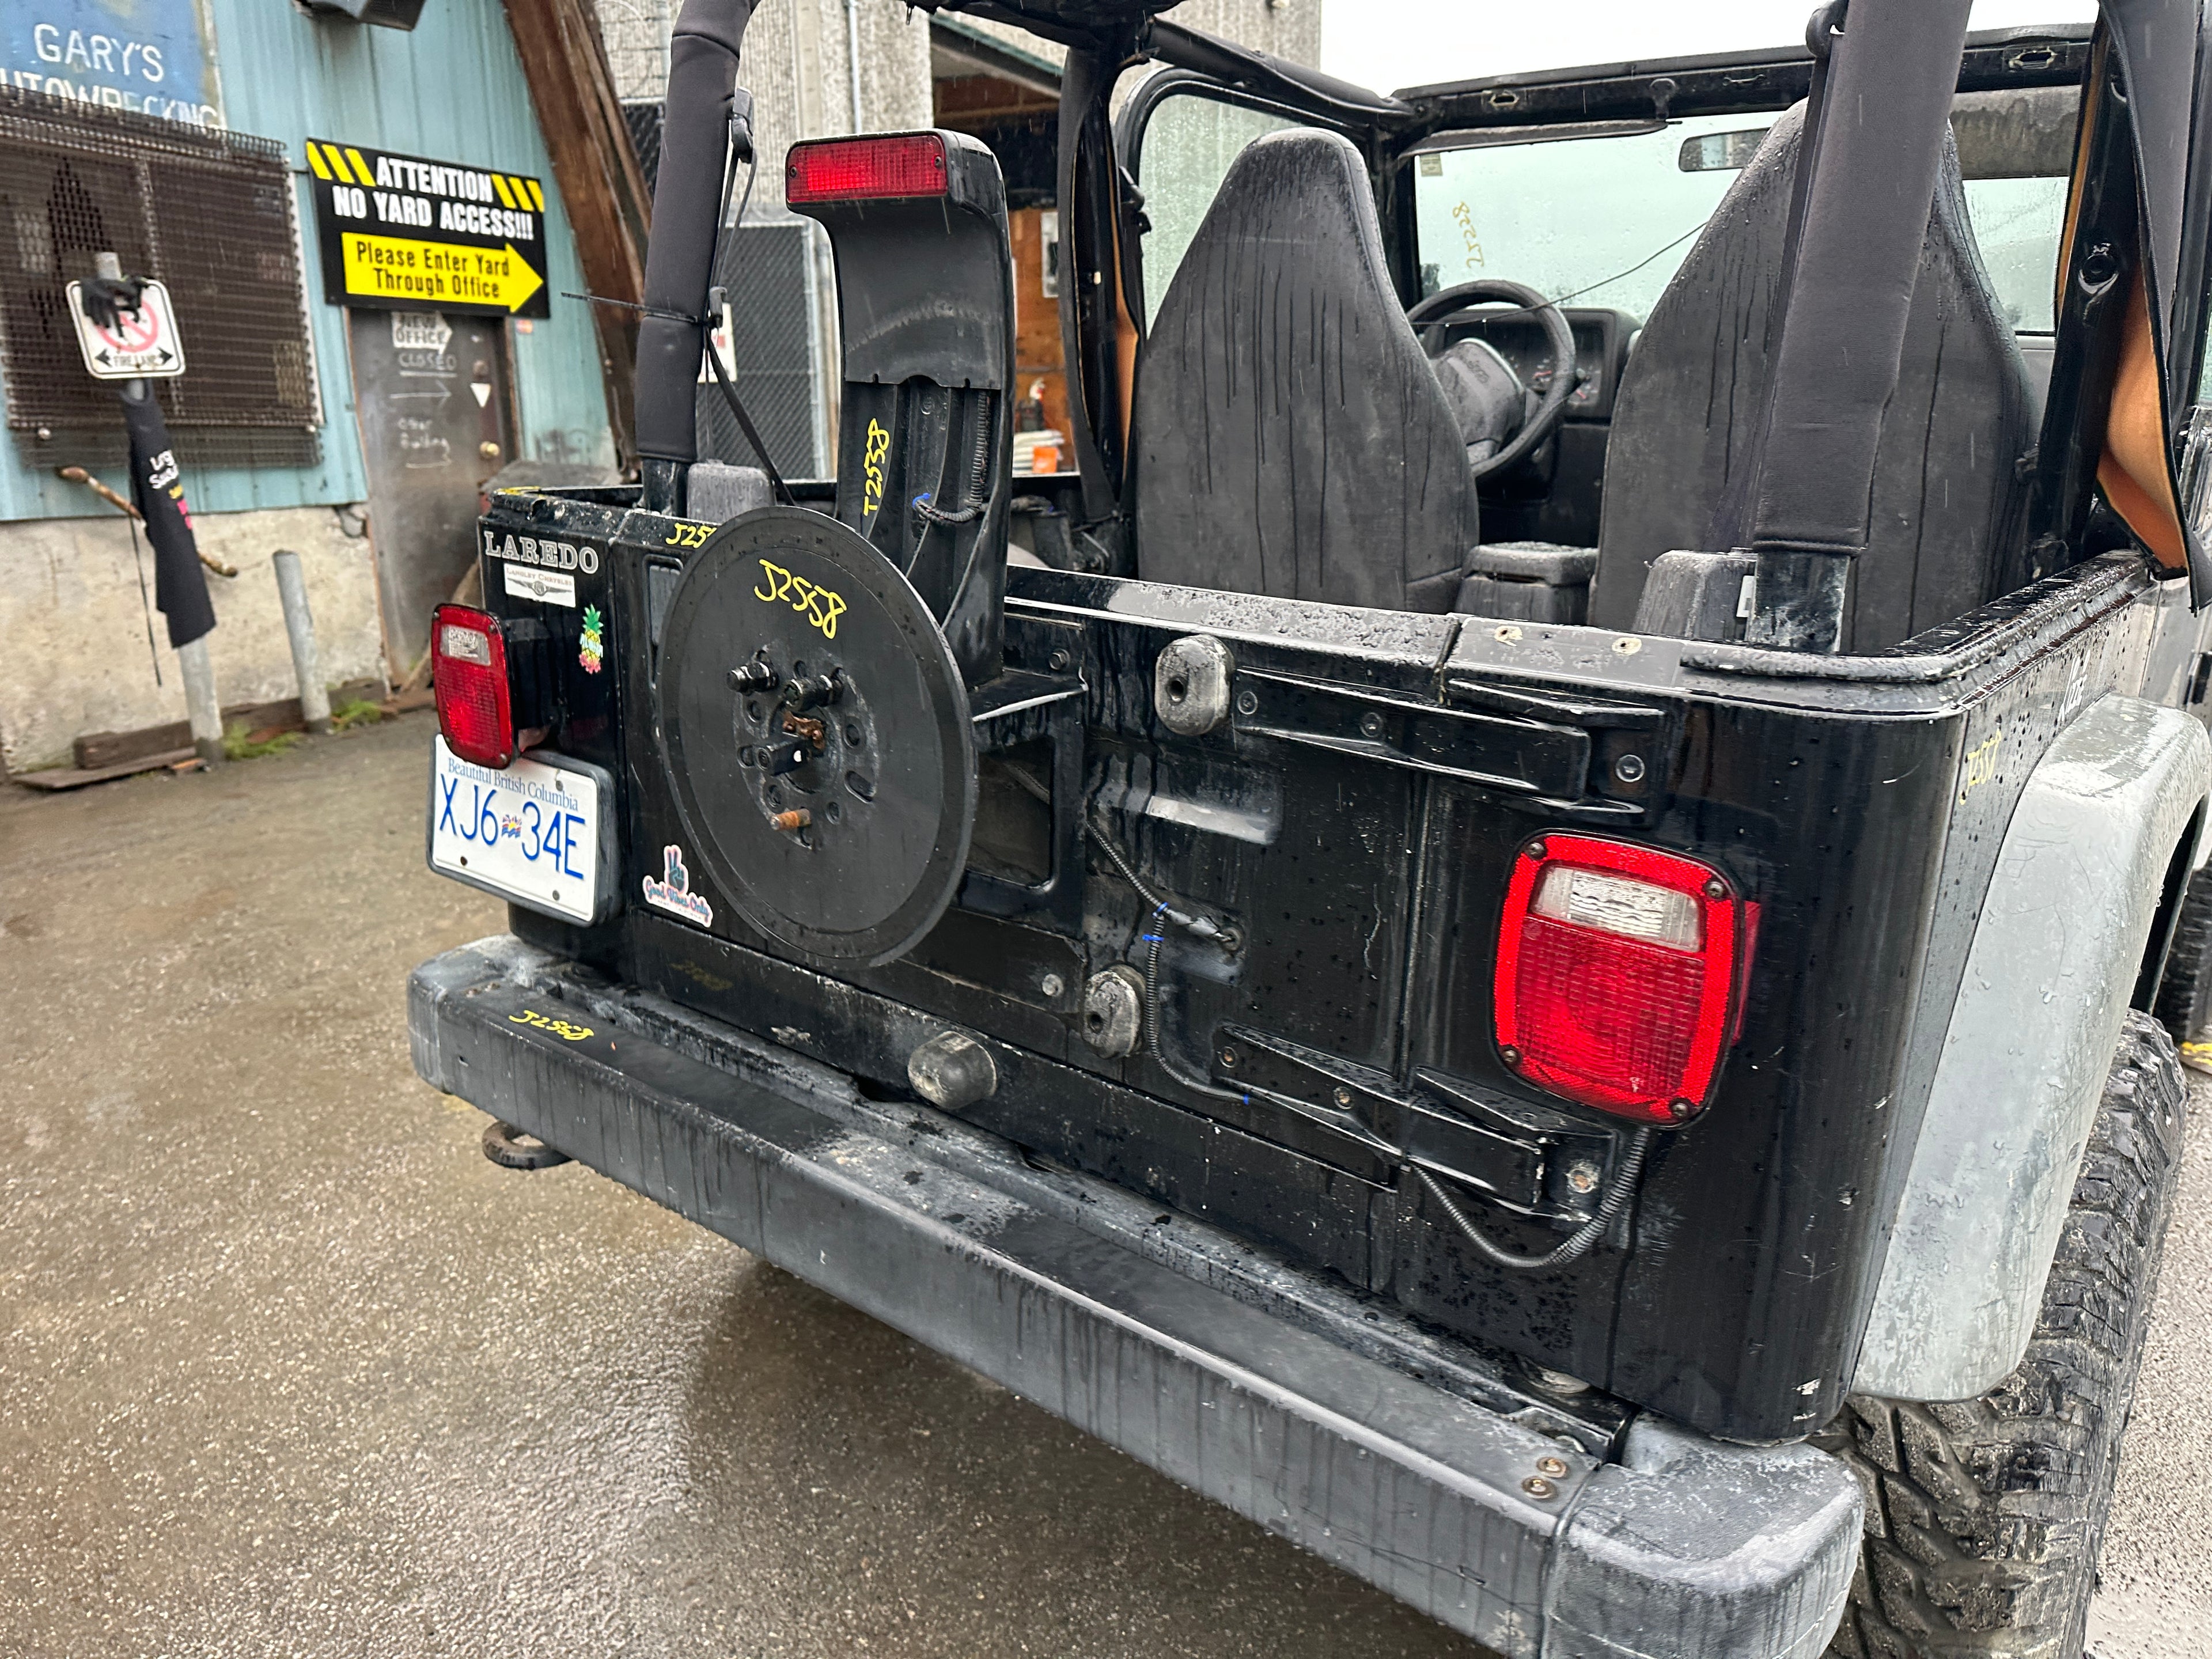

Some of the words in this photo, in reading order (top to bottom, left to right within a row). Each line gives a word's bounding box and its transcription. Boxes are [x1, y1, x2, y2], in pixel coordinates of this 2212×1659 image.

[34, 24, 164, 82] GARY'S
[376, 156, 493, 203] ATTENTION
[332, 185, 367, 219] NO
[372, 191, 433, 227] YARD
[440, 202, 535, 240] ACCESS!!!
[357, 241, 415, 267] Please
[425, 248, 467, 272] Enter
[475, 254, 509, 277] Yard
[374, 267, 444, 296] Through
[452, 274, 500, 298] Office
[396, 327, 445, 345] OFFICE
[398, 353, 457, 371] CLOSED
[484, 530, 599, 574] LAREDO
[665, 522, 717, 548] J25
[754, 559, 847, 639] J2558
[448, 758, 491, 785] Beautiful
[494, 771, 526, 796] British
[528, 781, 578, 812] Columbia
[440, 773, 499, 846] XJ6
[521, 801, 586, 880] 34E
[646, 879, 666, 899] Good
[690, 896, 710, 923] Only
